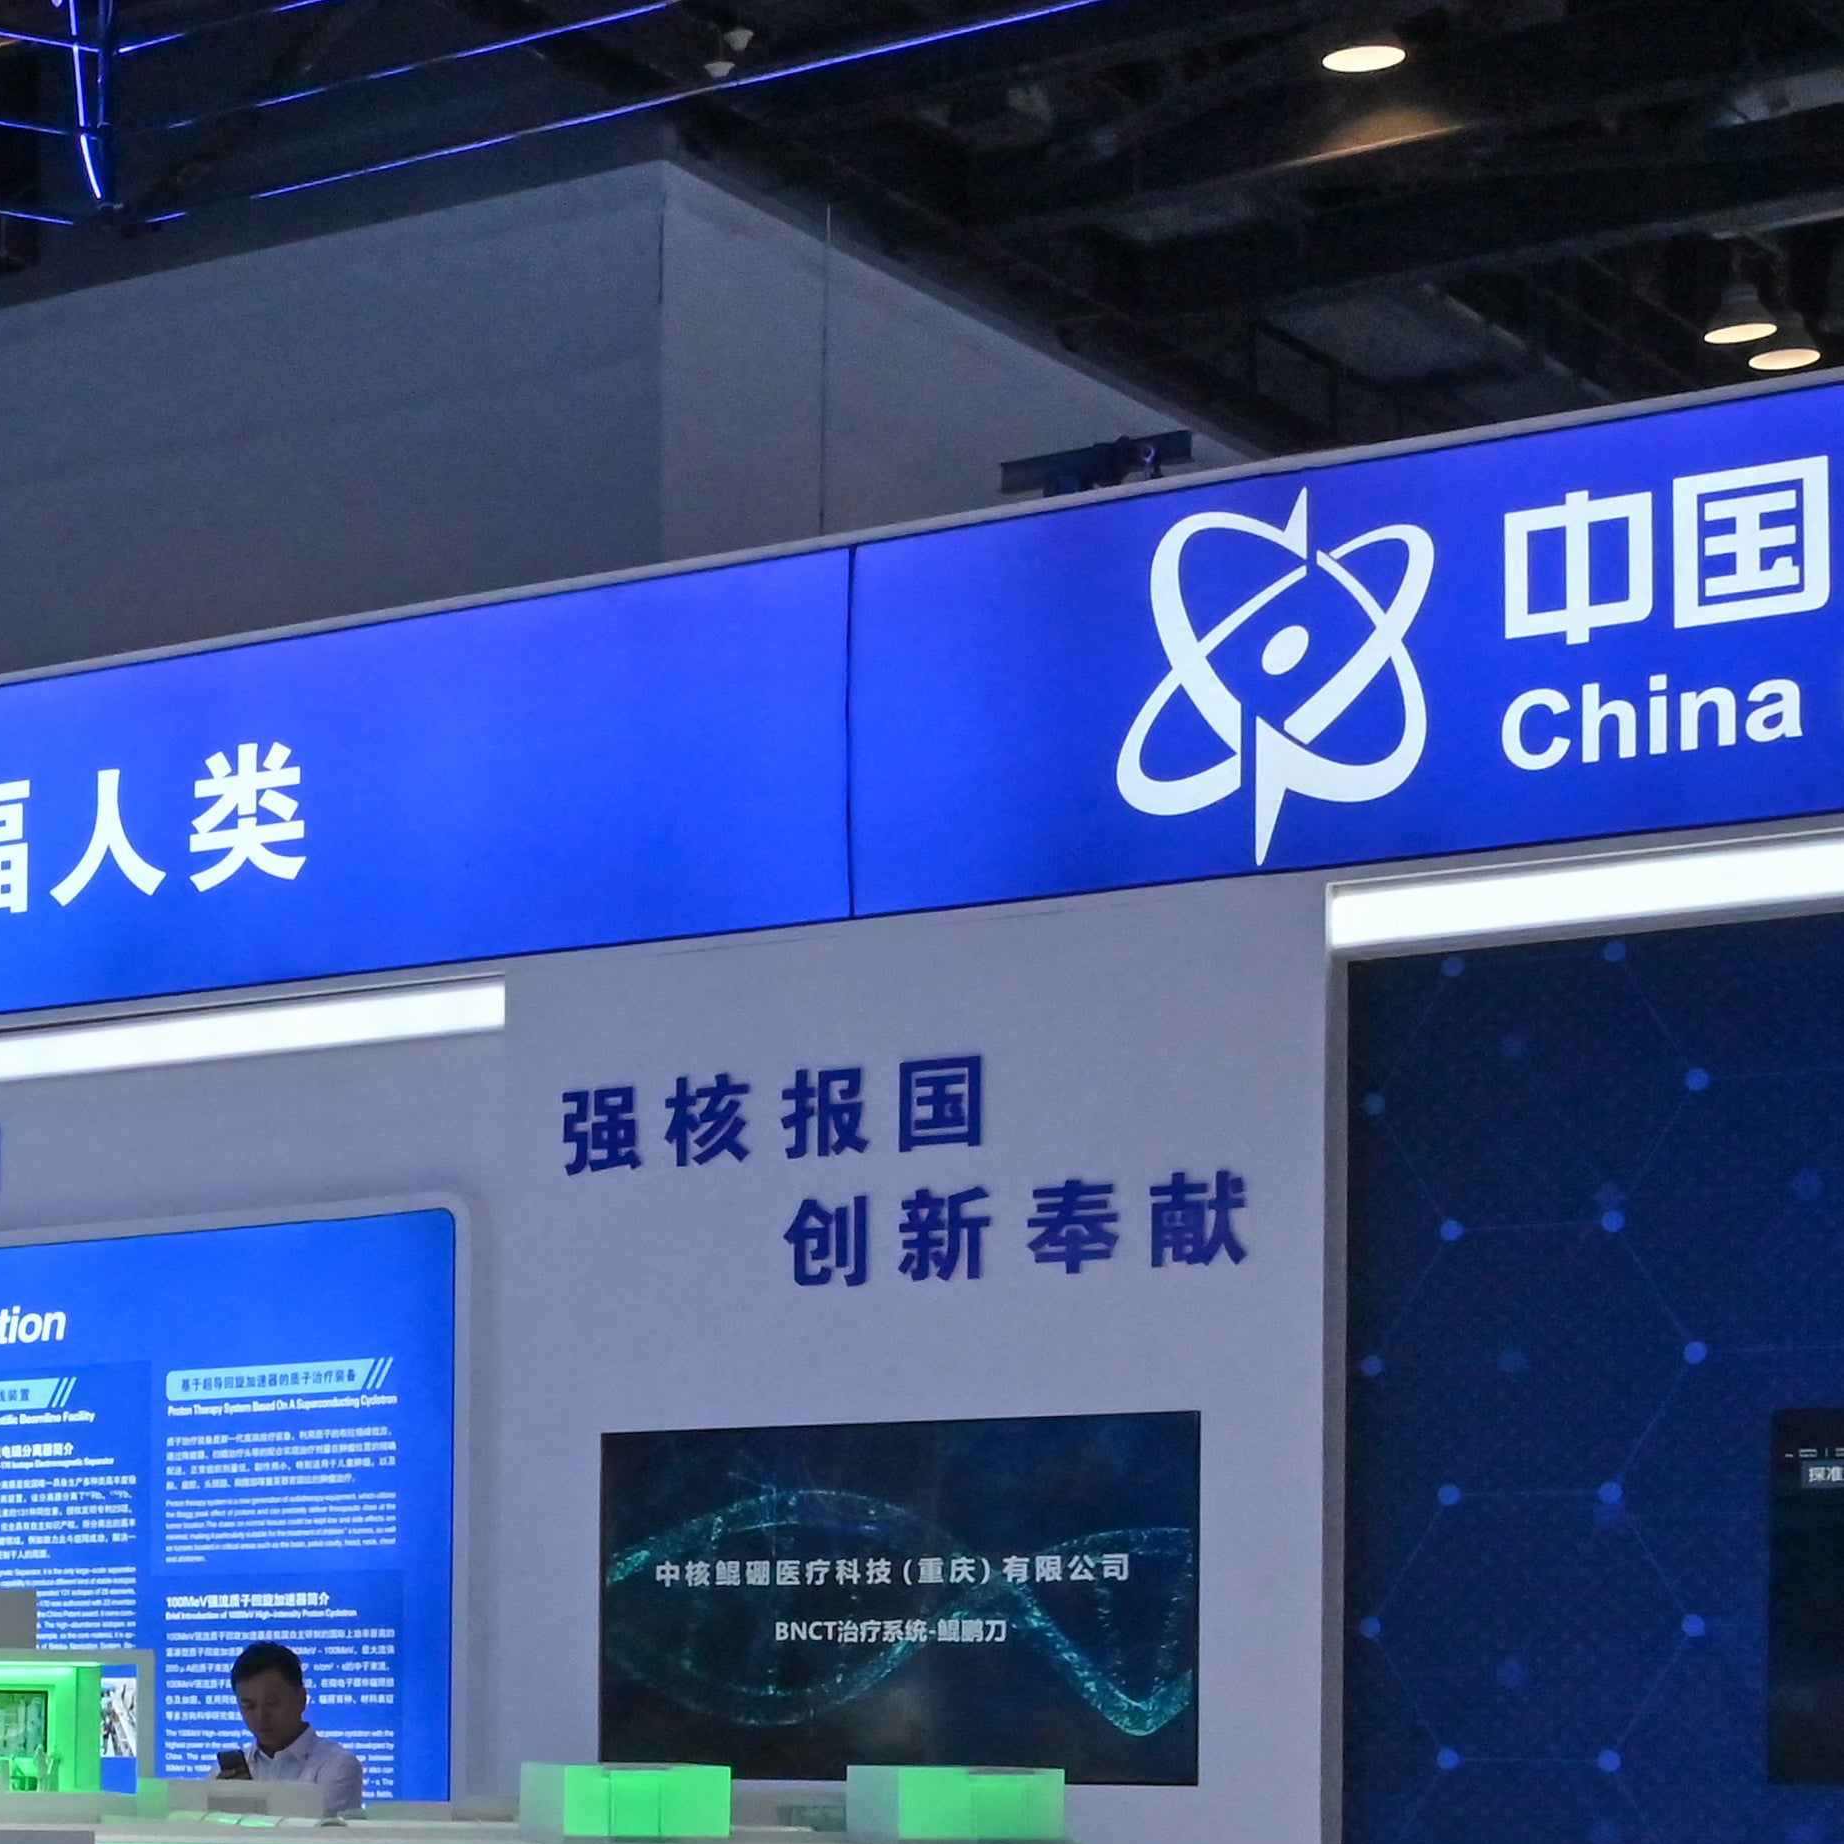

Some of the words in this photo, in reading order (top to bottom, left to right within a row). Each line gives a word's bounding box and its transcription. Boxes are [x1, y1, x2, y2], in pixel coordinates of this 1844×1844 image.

[1504, 455, 1829, 645] 中国
[1502, 674, 1804, 771] China
[561, 1055, 985, 1176] 强核报国
[784, 1170, 1248, 1288] 创新奉献
[20, 1412, 61, 1423] Beamline
[64, 1411, 95, 1423] Facility
[168, 1404, 192, 1415] Proton
[194, 1403, 223, 1415] Therapy
[224, 1401, 252, 1413] System
[253, 1400, 275, 1410] Based
[277, 1399, 288, 1409] On
[289, 1399, 295, 1408] A
[297, 1396, 360, 1410] Superconducting
[362, 1394, 397, 1406] Cyclotron
[774, 1617, 1007, 1644] BNCT治疗系统-鲲鹏刀
